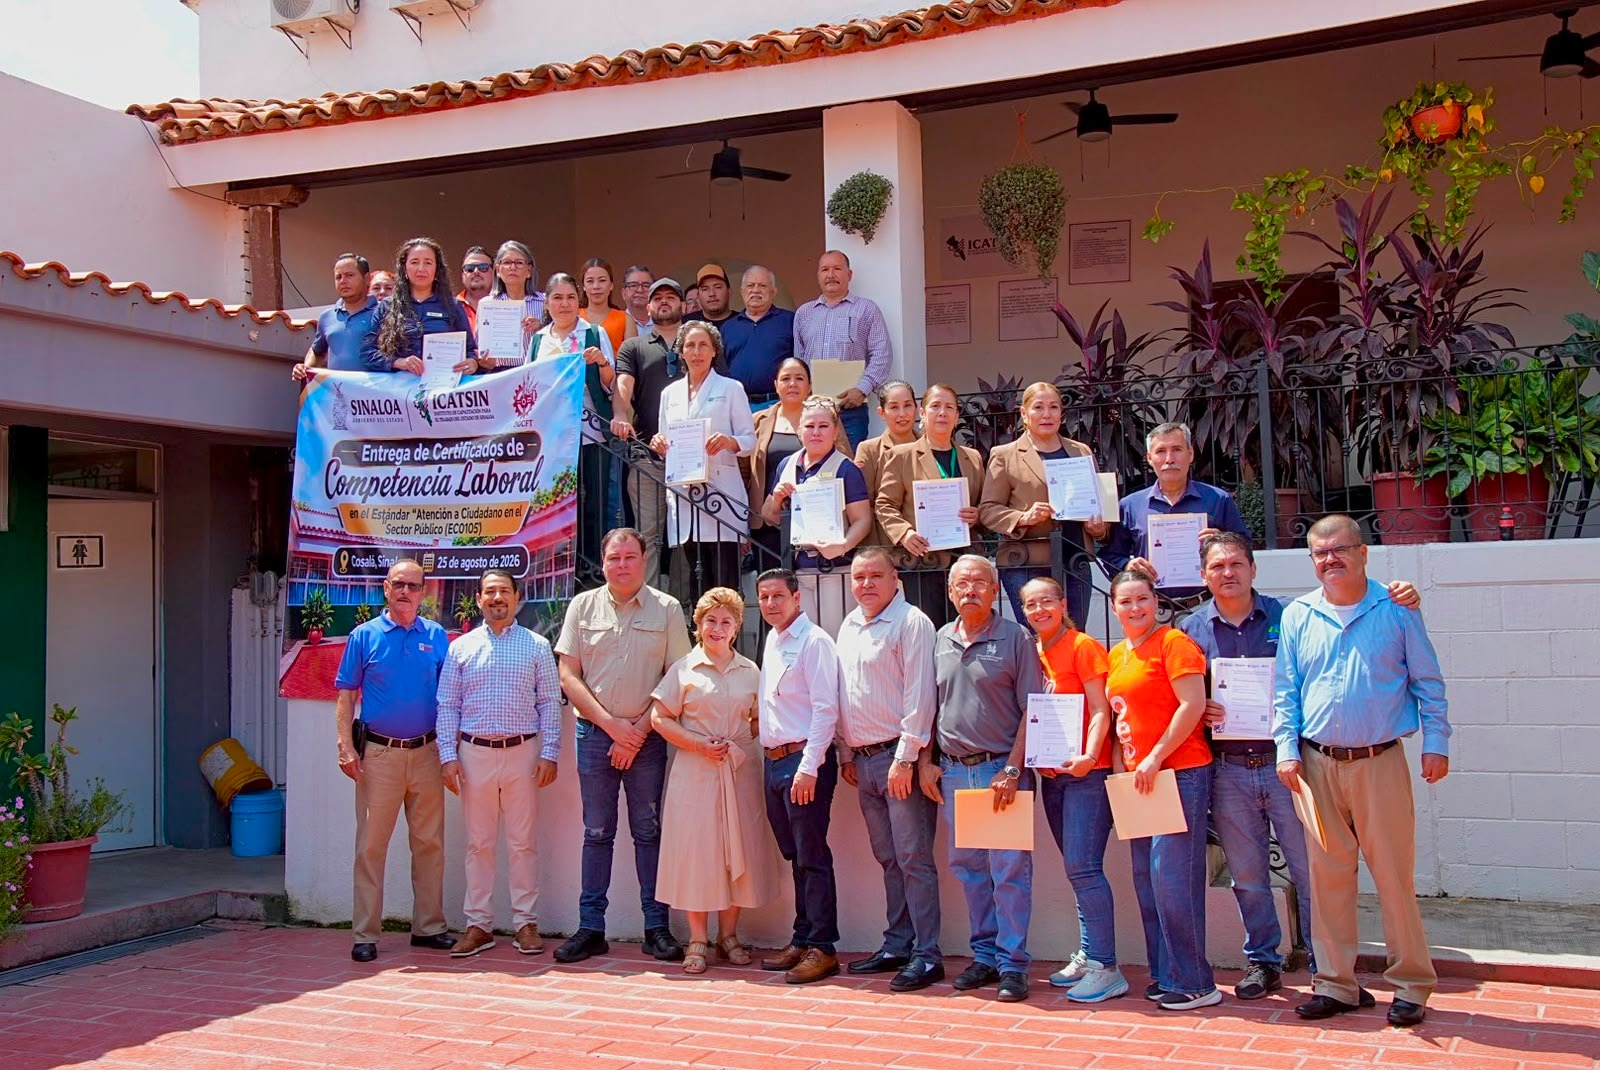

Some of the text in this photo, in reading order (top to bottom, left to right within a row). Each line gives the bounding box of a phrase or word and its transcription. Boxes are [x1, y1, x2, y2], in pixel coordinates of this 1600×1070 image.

[968, 237, 997, 250] ICAT
[350, 399, 402, 416] SINALOA
[432, 389, 490, 409] ICATSIN
[361, 437, 525, 465] Entrega de Certificados de
[324, 455, 545, 504] Competencia Laboral
[349, 510, 359, 519] en
[360, 508, 369, 519] el
[371, 508, 410, 520] Estándar
[454, 511, 459, 519] a
[461, 506, 503, 519] Ciudadano
[504, 508, 514, 517] en
[515, 505, 522, 517] el
[414, 521, 443, 535] Público
[351, 554, 378, 569] Cosalá,
[437, 554, 521, 571] 25 de agosto de 2026
